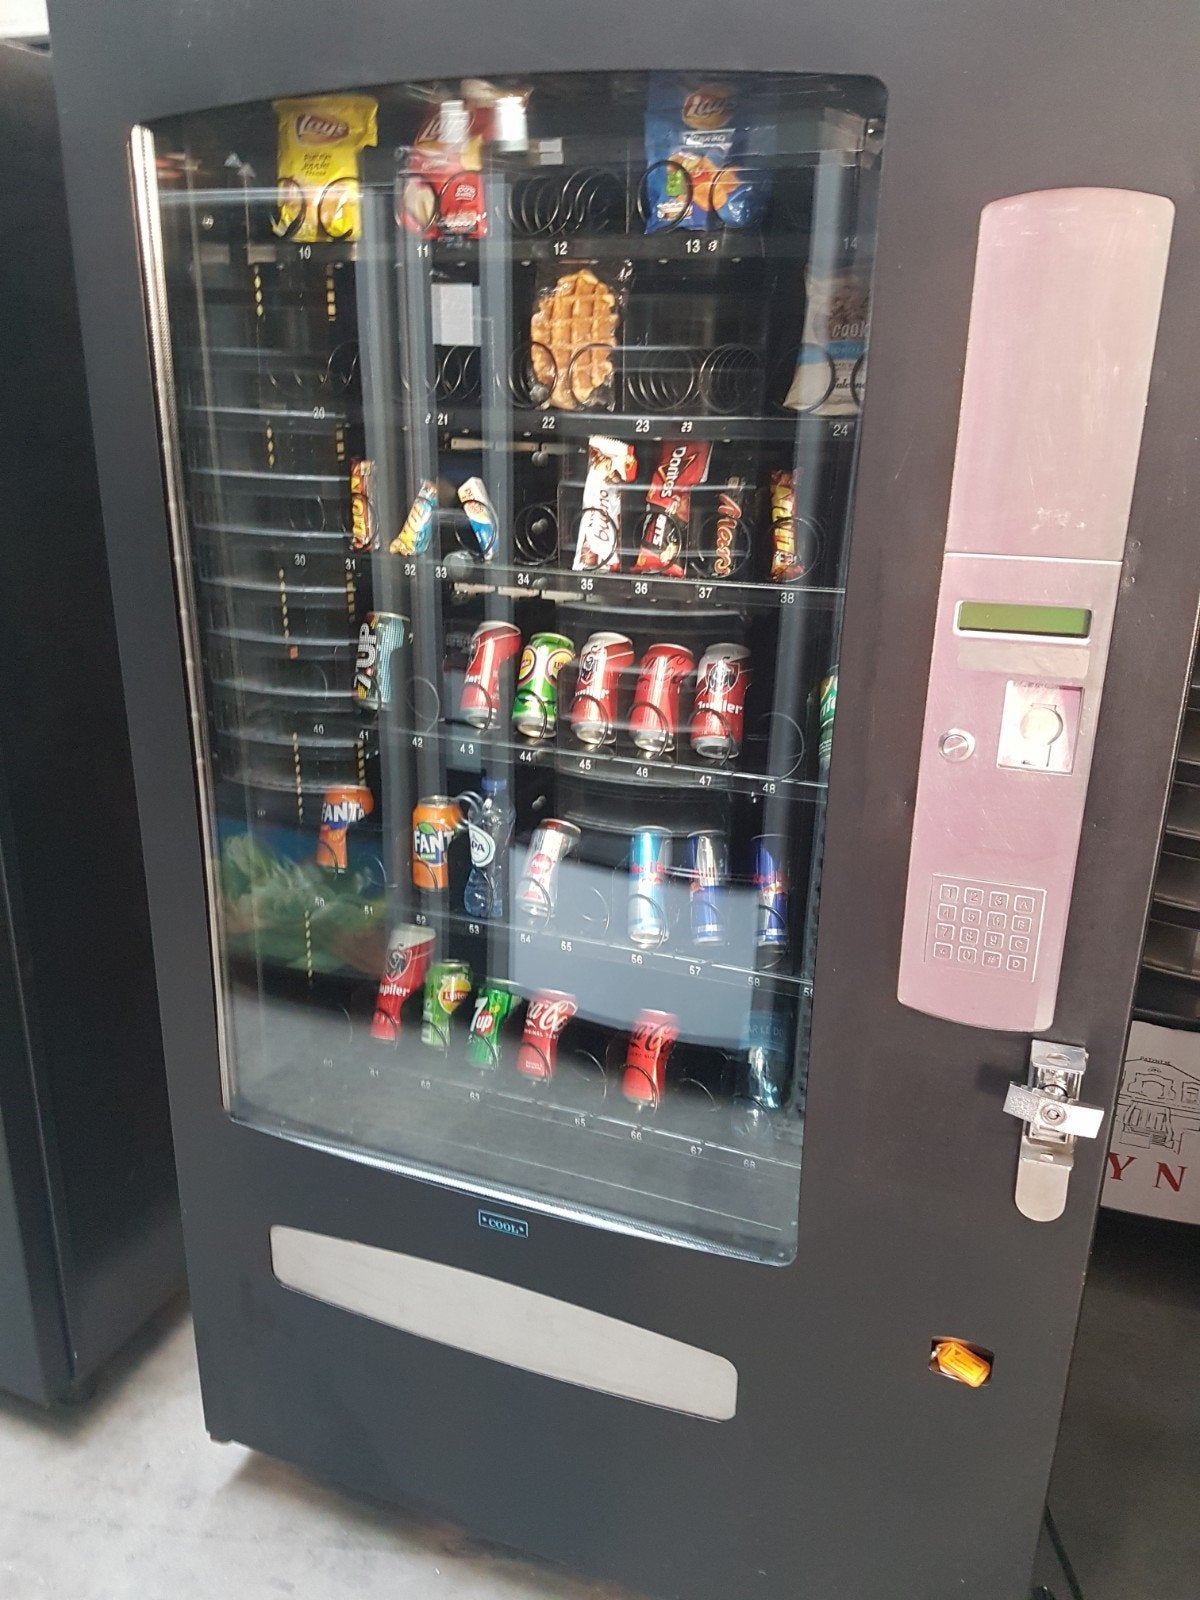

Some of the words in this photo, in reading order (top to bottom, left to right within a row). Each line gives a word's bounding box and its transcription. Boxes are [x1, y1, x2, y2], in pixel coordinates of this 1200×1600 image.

[417, 244, 429, 258] 11
[553, 241, 568, 256] 12
[685, 238, 701, 253] 13
[299, 245, 311, 260] 10
[312, 406, 325, 420] 20
[437, 412, 448, 426] 21
[542, 416, 555, 429] 22
[635, 419, 650, 433] 23
[832, 424, 848, 437] 24
[660, 446, 688, 498] Doritos
[594, 489, 610, 541] bueno
[714, 493, 742, 575] Mars
[294, 553, 306, 567] 30
[345, 557, 356, 571] 31
[404, 563, 416, 576] 32
[435, 566, 448, 579] 33
[517, 572, 530, 586] 34
[580, 578, 594, 591] 35
[634, 582, 648, 595] 36
[698, 587, 713, 599] 37
[780, 592, 795, 604] 38
[313, 723, 324, 735] 40
[359, 729, 369, 741] 41
[412, 736, 423, 748] 42
[519, 750, 532, 762] 44
[579, 758, 591, 771] 45
[636, 766, 648, 778] 46
[699, 775, 712, 786] 47
[762, 783, 776, 794] 48
[520, 933, 531, 944] 54
[560, 940, 572, 952] 55
[631, 953, 643, 965] 56
[689, 964, 702, 976] 57
[747, 976, 760, 987] 58
[630, 1129, 642, 1141] 66
[690, 1145, 703, 1156] 67
[488, 1218, 519, 1235] COOL
